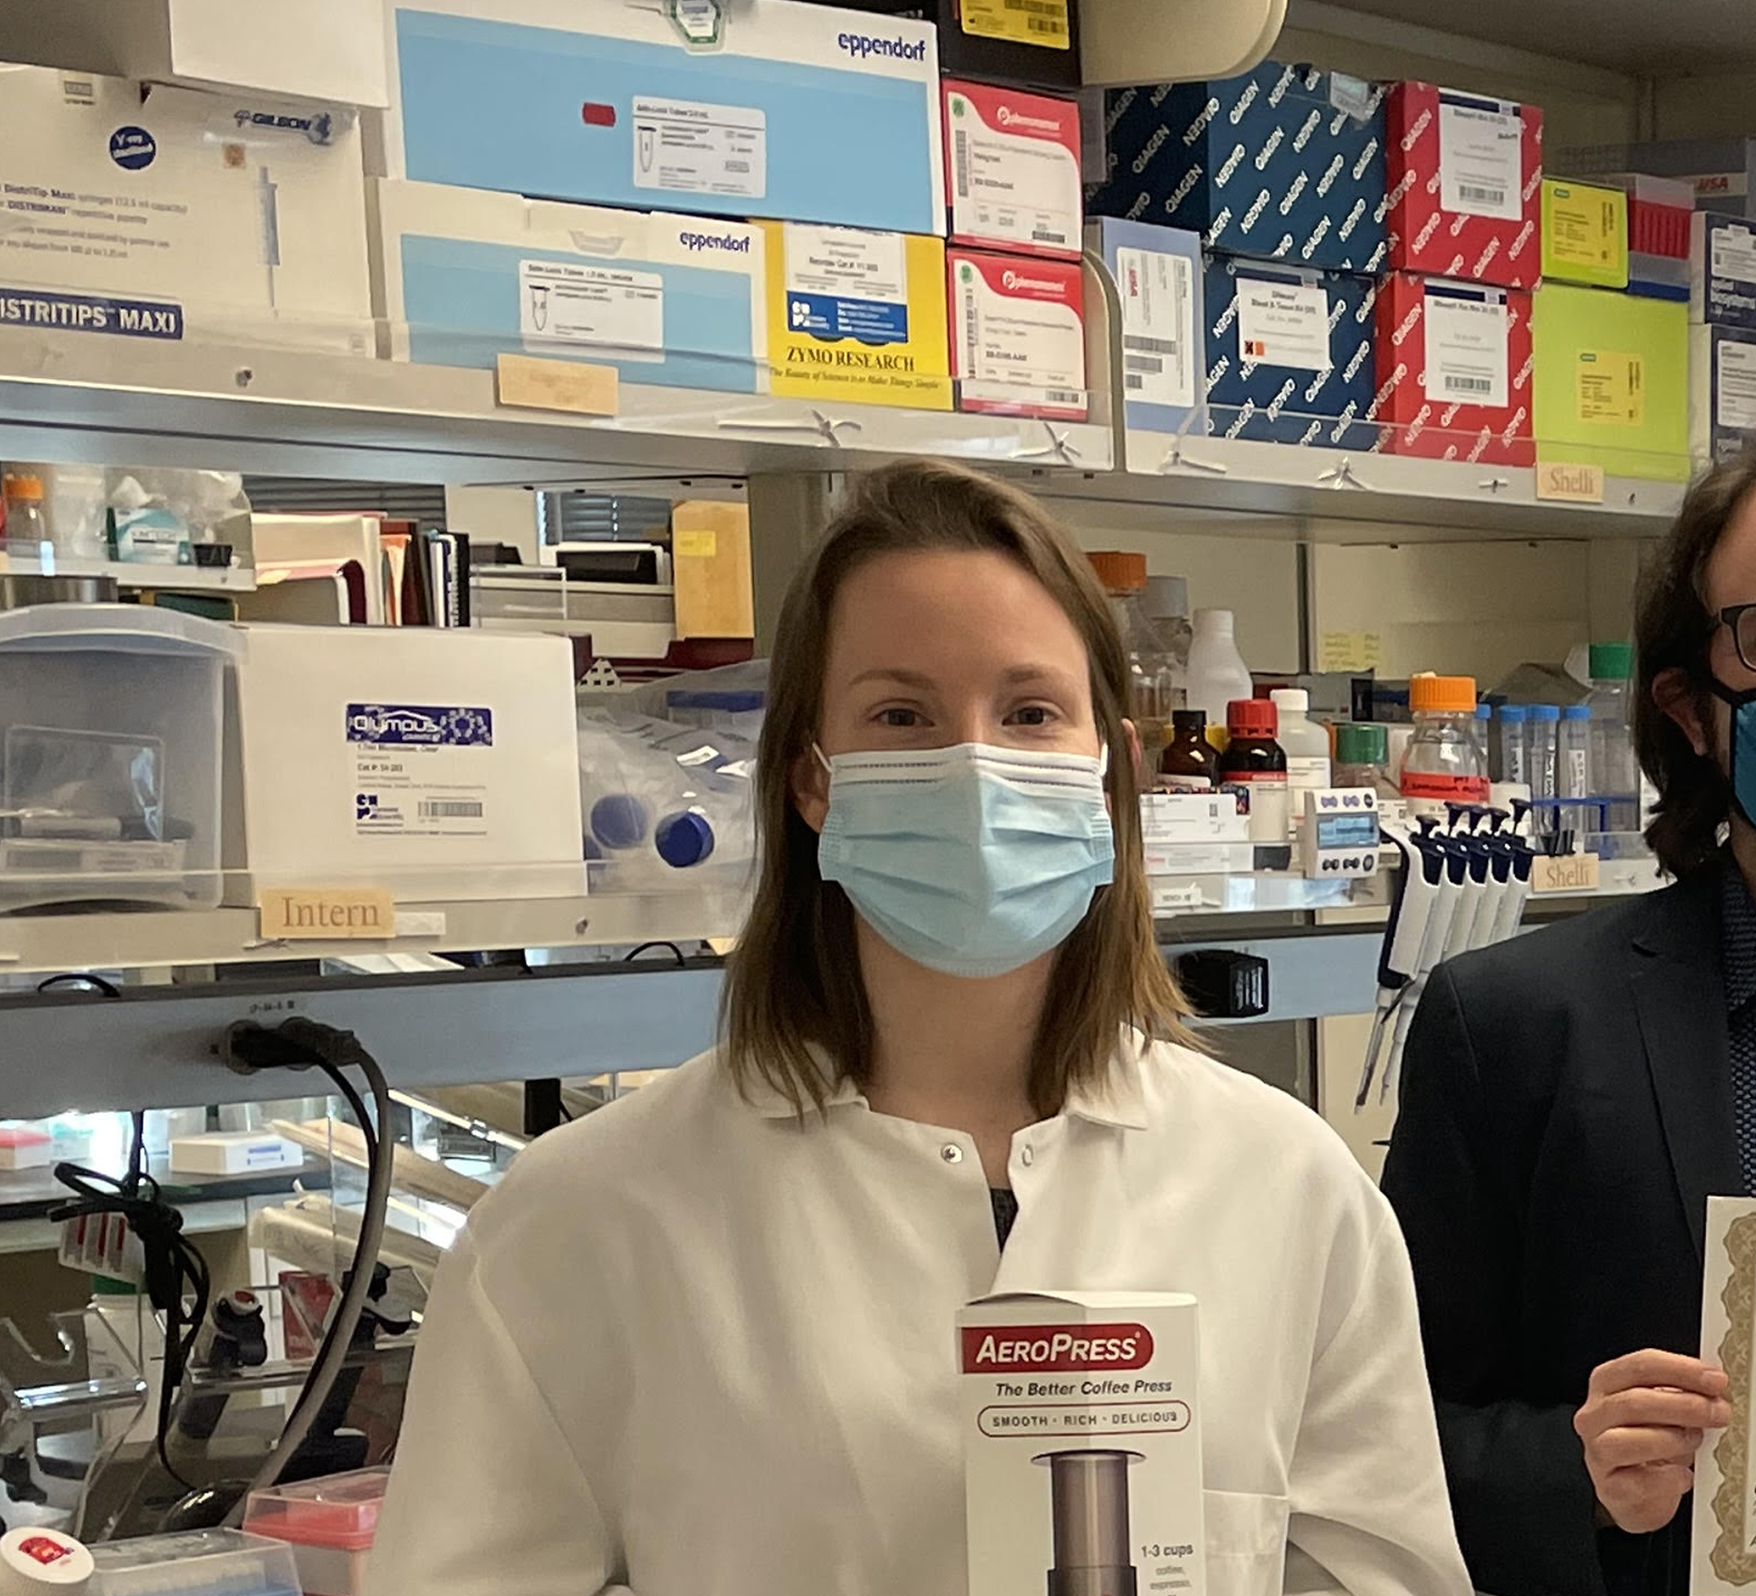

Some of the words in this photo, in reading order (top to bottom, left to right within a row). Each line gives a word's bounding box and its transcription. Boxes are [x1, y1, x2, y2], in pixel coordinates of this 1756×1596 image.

[838, 30, 926, 62] eppendorf
[1229, 79, 1260, 125] QIAGEN
[1182, 97, 1220, 146] QIAGEN
[1132, 123, 1170, 173] QIAGEN
[1255, 125, 1285, 170] QIAGEN
[1215, 144, 1245, 188] QIAGEN
[1165, 163, 1203, 213] QIAGEN
[1240, 189, 1270, 234] QIAGEN
[679, 231, 750, 253] eppendorf
[119, 307, 176, 333] MAXI
[787, 346, 833, 364] ZYMO
[836, 352, 915, 372] RESEARCH
[282, 897, 380, 928] Intern
[996, 1383, 1023, 1397] The
[1028, 1382, 1075, 1396] Better
[1081, 1380, 1129, 1395] Coffee
[1134, 1380, 1172, 1393] Press
[993, 1416, 1048, 1427] SMOOTH
[1064, 1415, 1097, 1426] RICH
[1112, 1411, 1177, 1424] DELICIOUS
[1141, 1544, 1160, 1558] 1-3
[1163, 1544, 1194, 1558] cups
